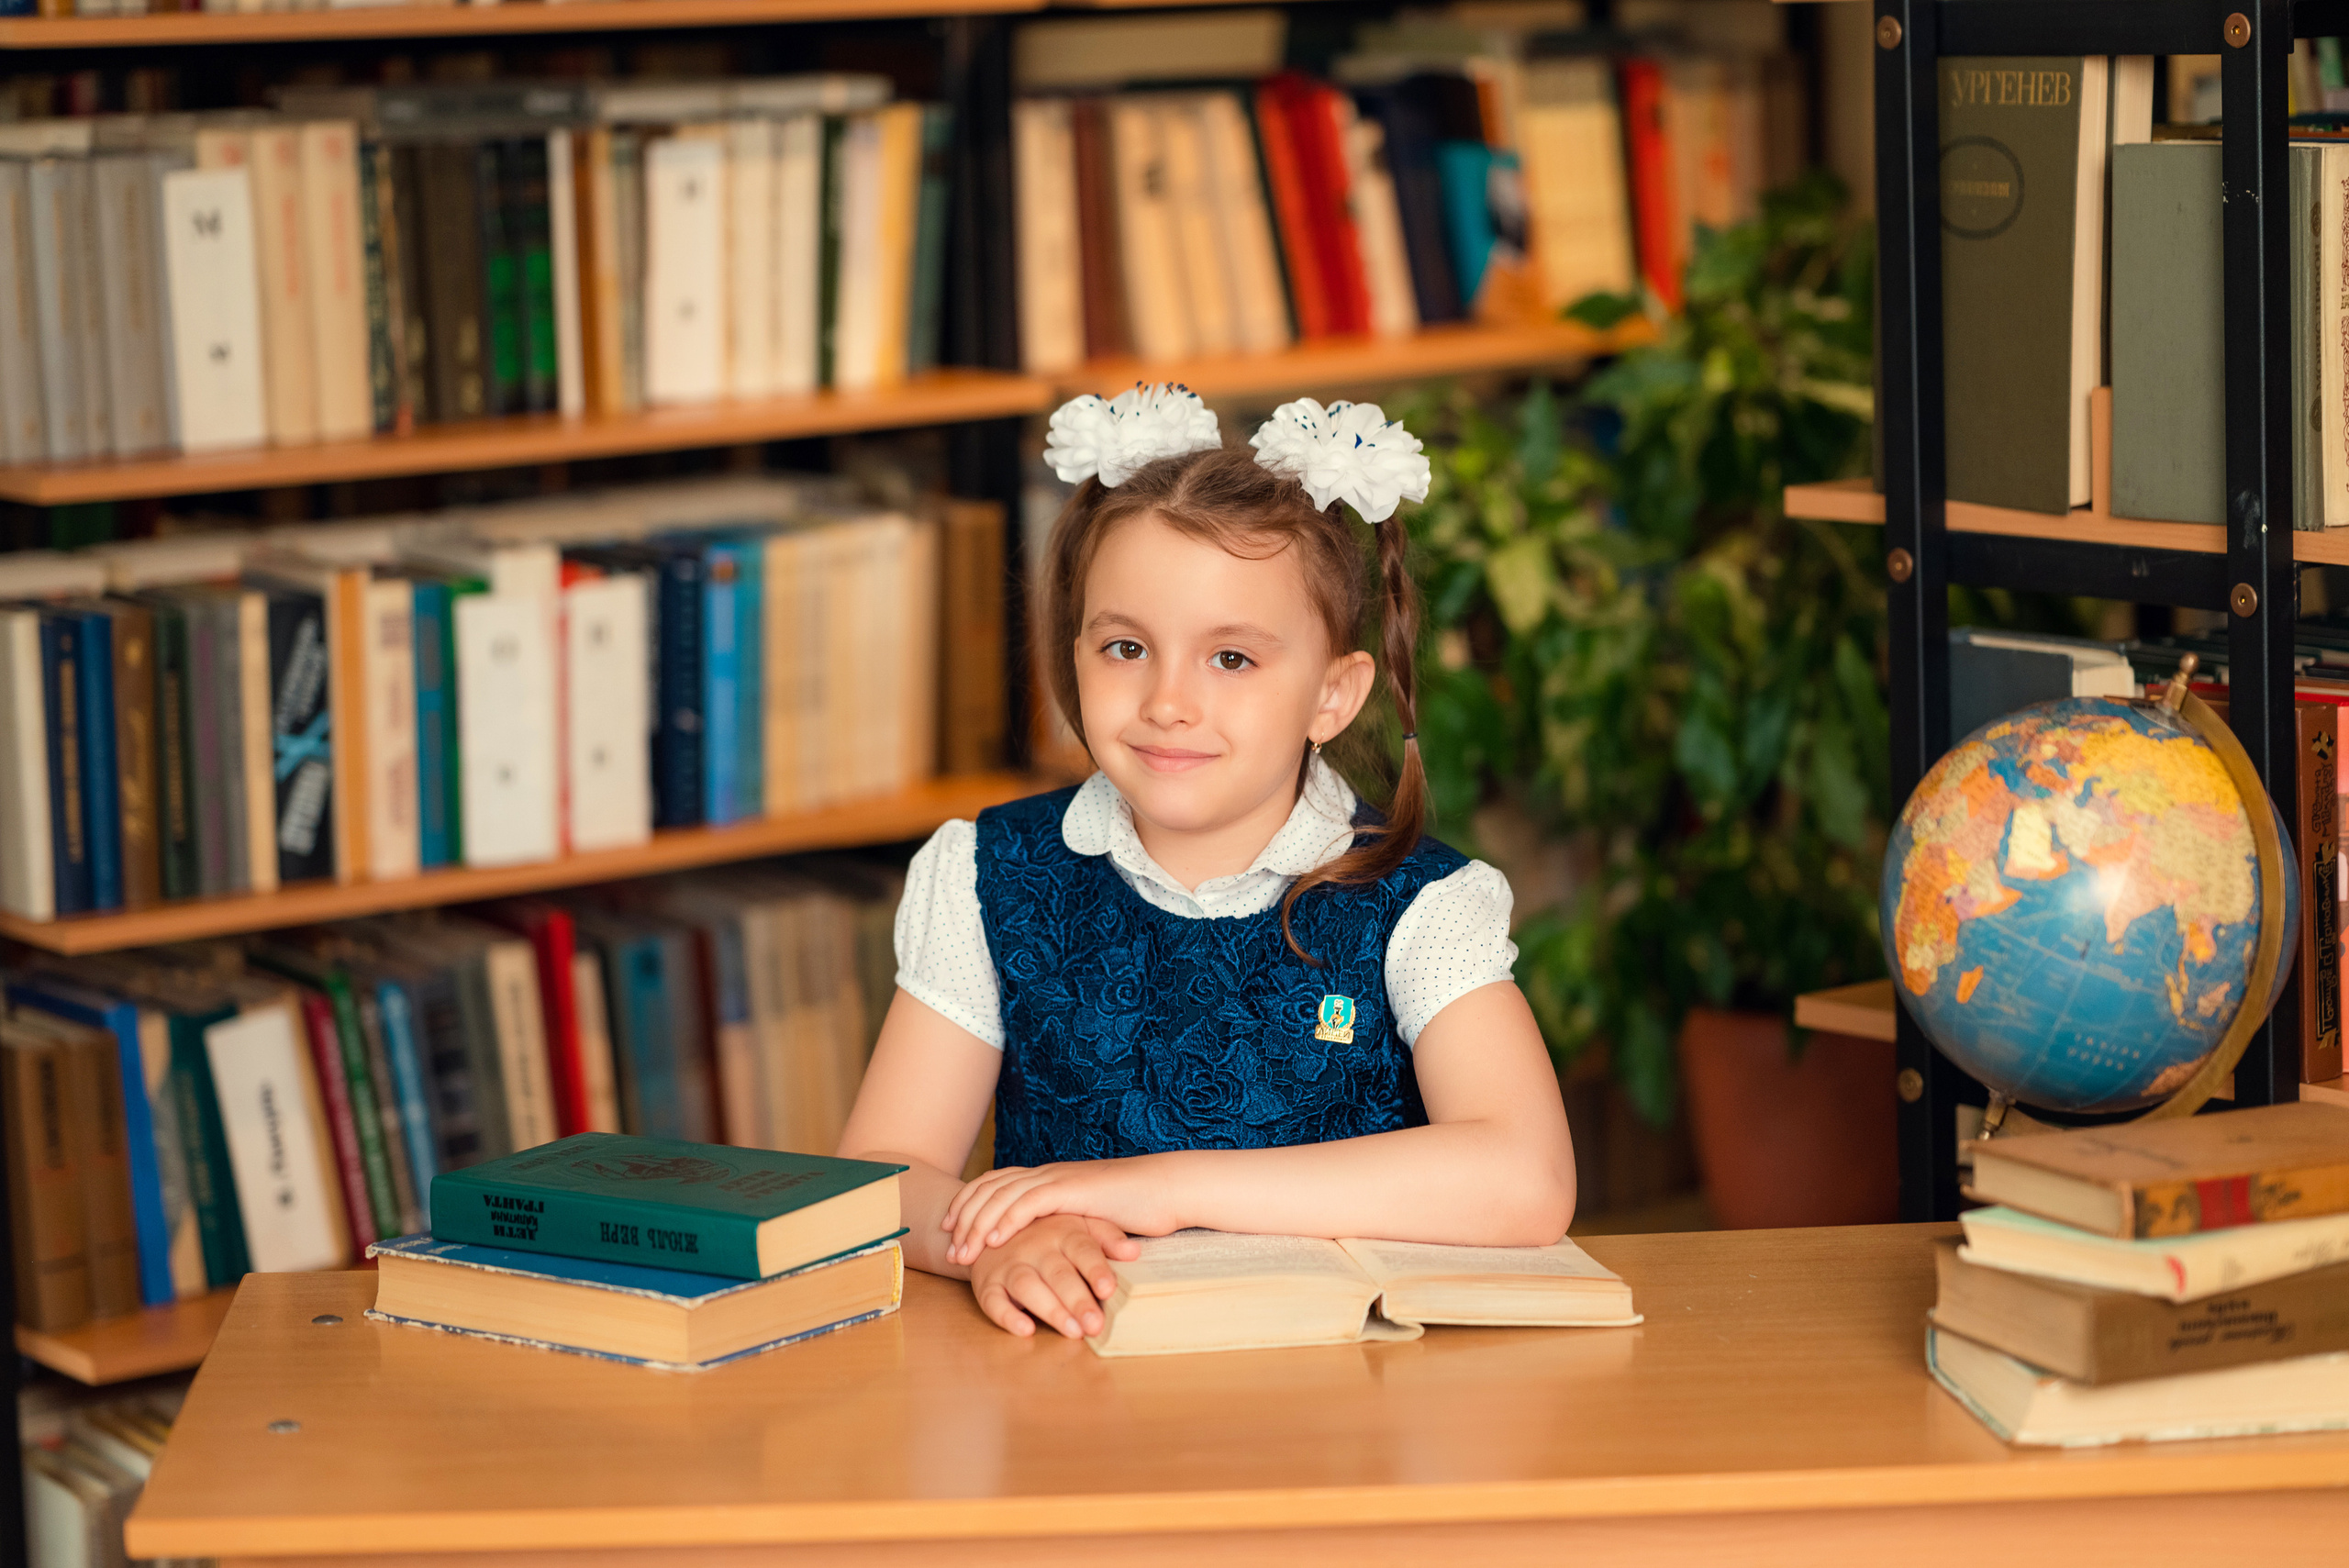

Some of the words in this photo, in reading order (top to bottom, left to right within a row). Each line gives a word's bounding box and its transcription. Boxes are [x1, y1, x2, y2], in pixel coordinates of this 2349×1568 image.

[1951, 71, 2071, 108] УРГЕНЕВ
[483, 1195, 544, 1213] ГРАНТА
[494, 1225, 538, 1240] ДЕТИ
[600, 1221, 639, 1246] ВЕРН
[647, 1228, 699, 1253] ЖЮЛЬ
